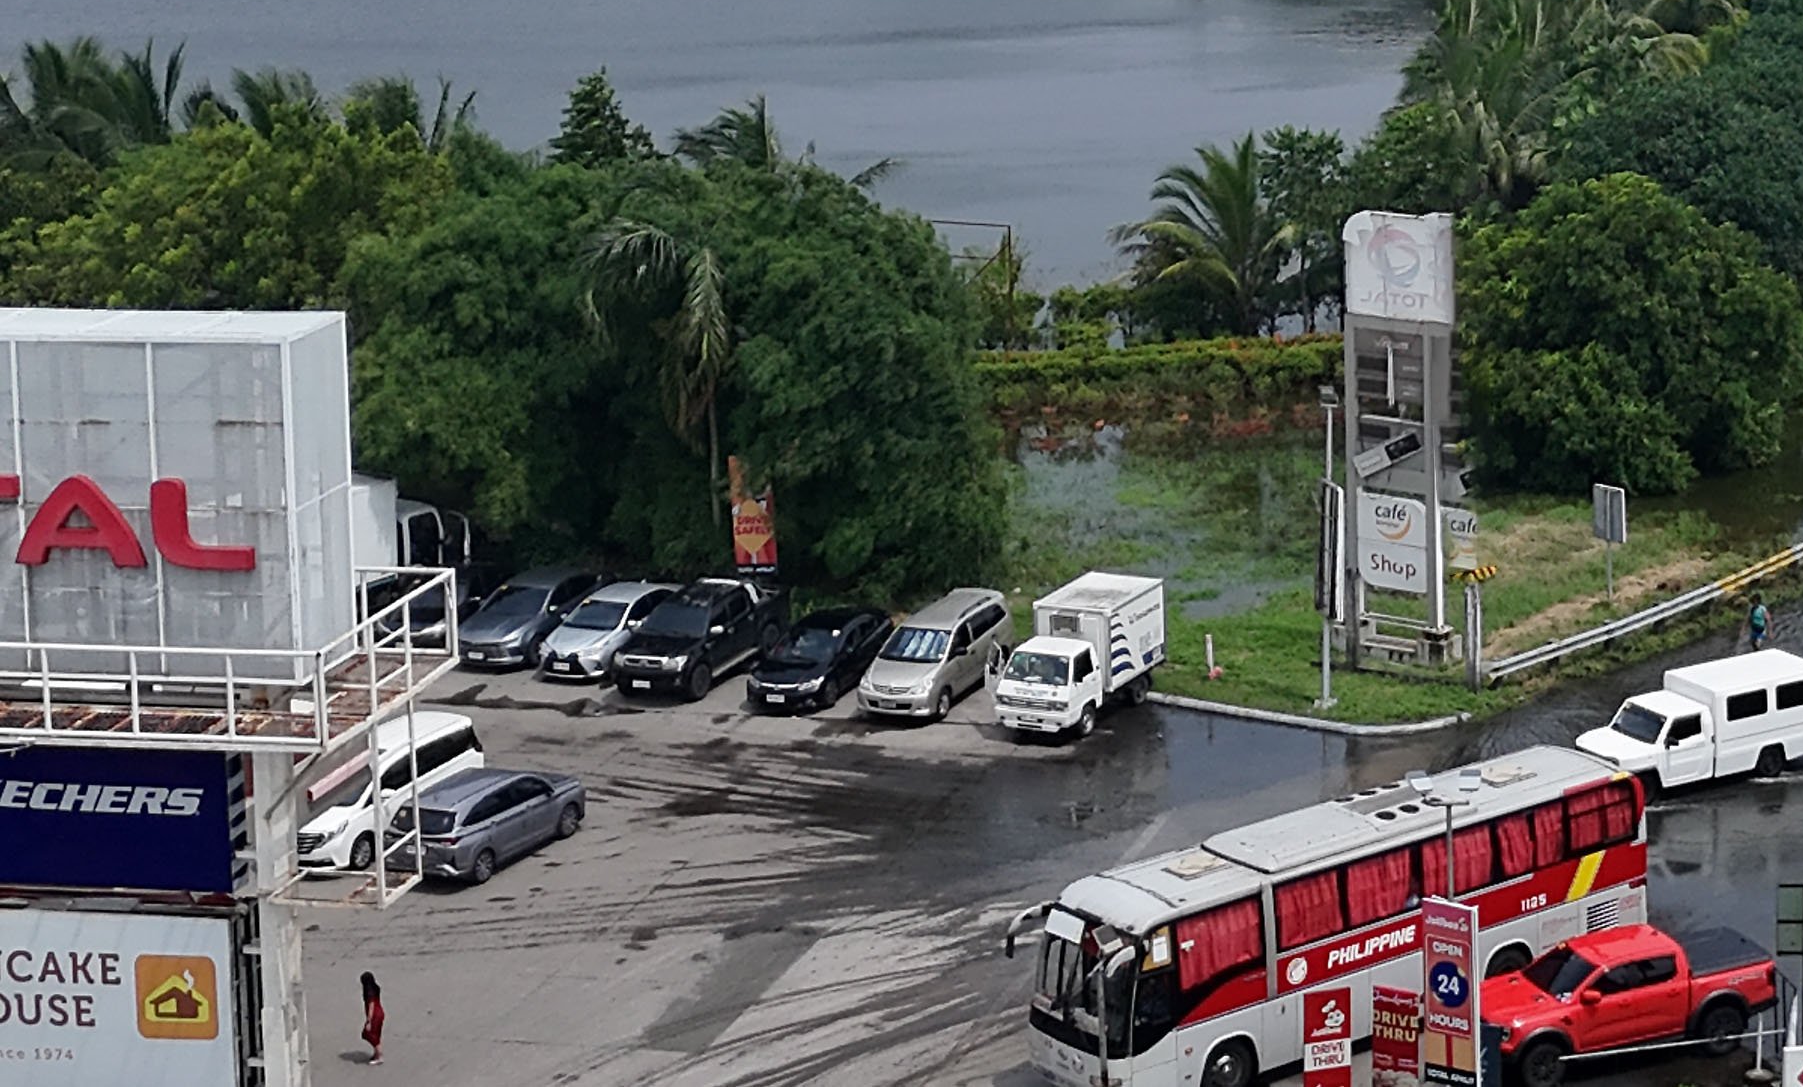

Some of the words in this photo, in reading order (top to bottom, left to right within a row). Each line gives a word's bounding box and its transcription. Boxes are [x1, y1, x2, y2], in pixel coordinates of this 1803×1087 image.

[1375, 501, 1407, 521] café
[0, 474, 256, 572] AL
[1370, 553, 1417, 581] Shop
[0, 779, 204, 815] ECHERS
[1327, 924, 1416, 969] PHILIPPINE
[1432, 941, 1463, 957] OPEN
[0, 950, 121, 985] CAKE
[1437, 974, 1460, 995] 24
[1373, 1009, 1419, 1028] DRIVE
[1429, 1014, 1469, 1031] HOURS
[1374, 1024, 1417, 1042] THRU
[34, 1048, 74, 1060] 1974
[1313, 1054, 1345, 1067] THRU
